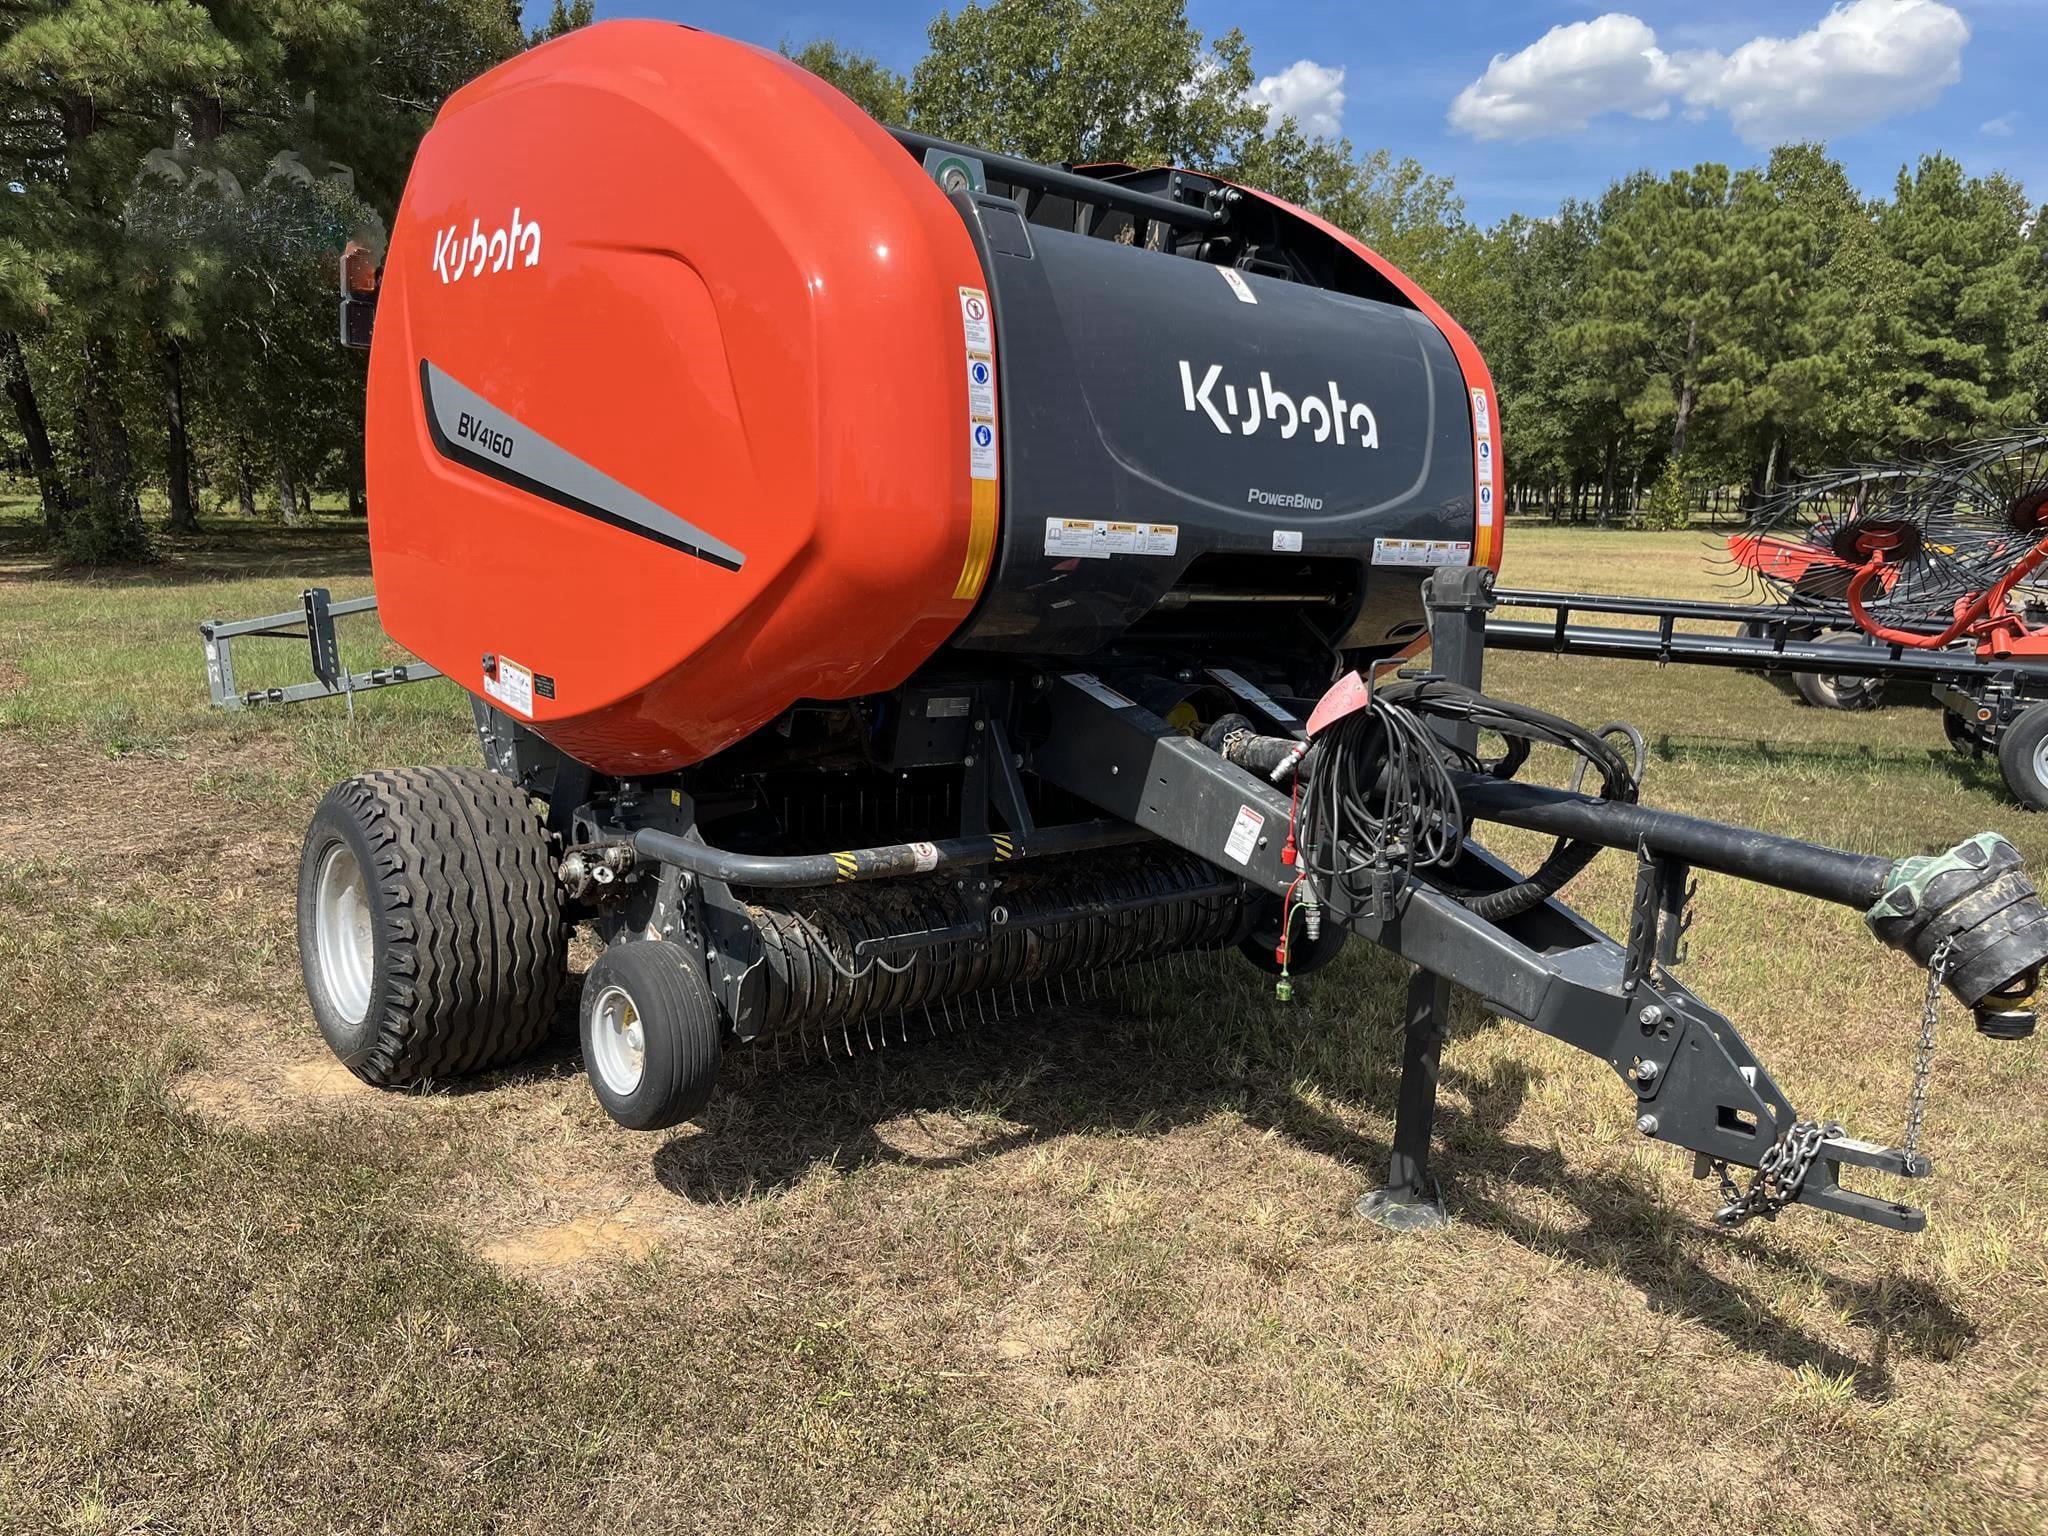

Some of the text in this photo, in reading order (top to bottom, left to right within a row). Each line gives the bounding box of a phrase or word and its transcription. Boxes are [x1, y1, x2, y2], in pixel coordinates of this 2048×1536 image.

[433, 207, 541, 284] Kubota
[457, 412, 514, 459] BV4160
[1178, 360, 1379, 449] Kubota
